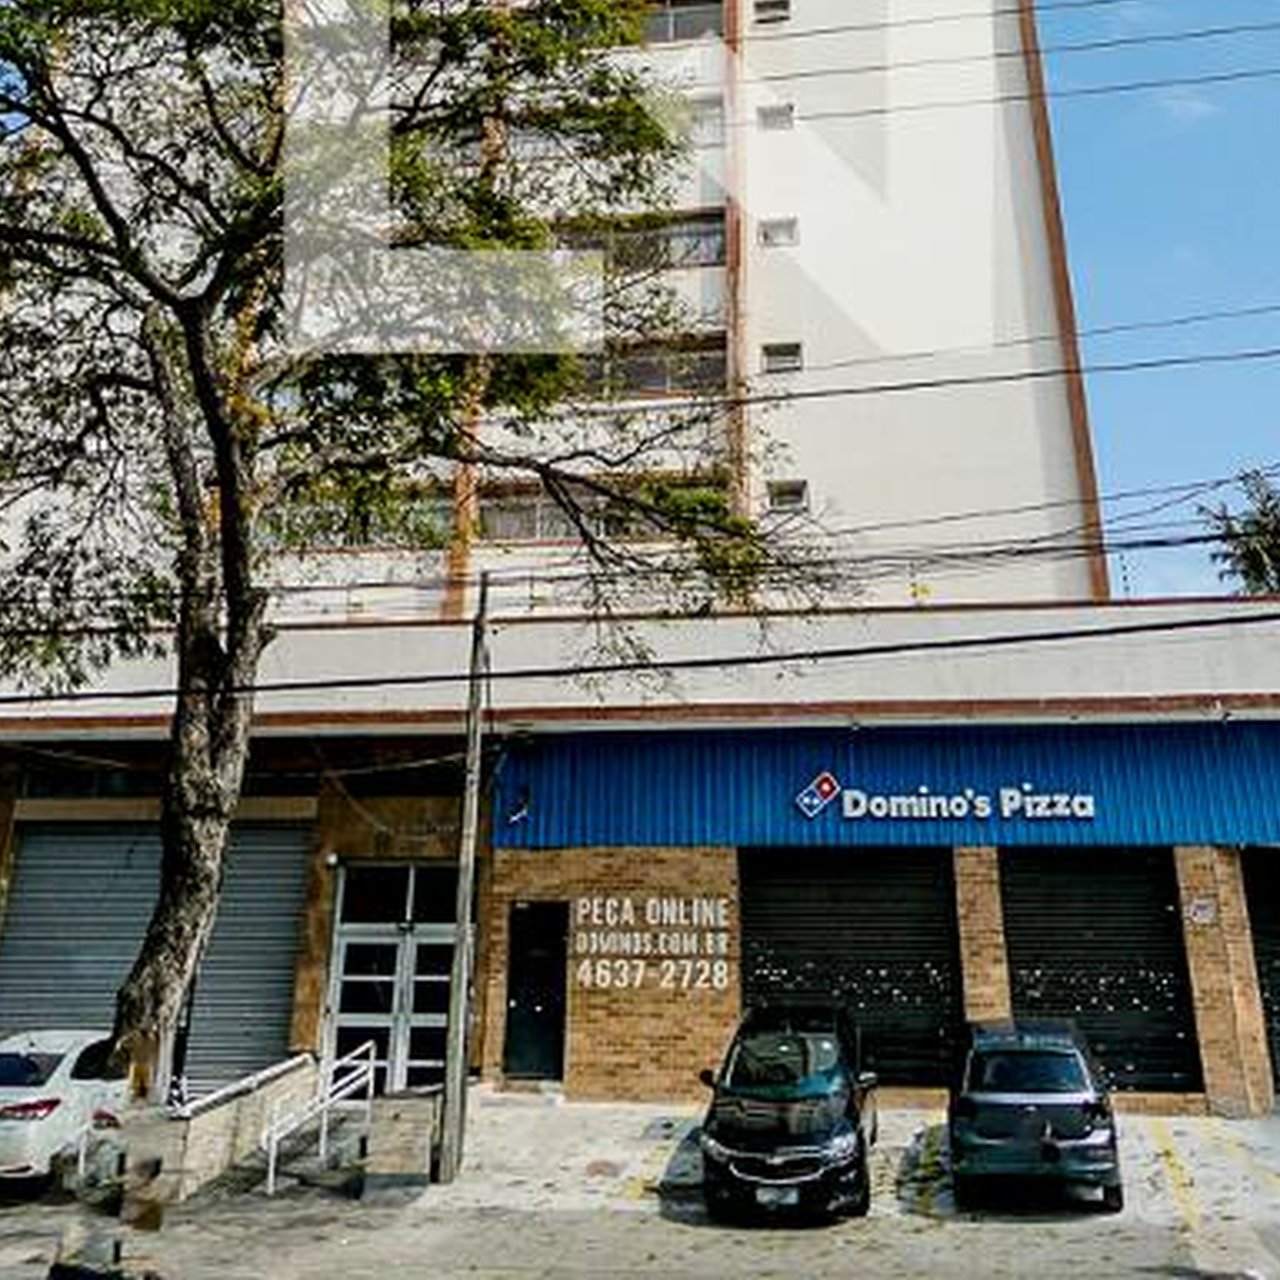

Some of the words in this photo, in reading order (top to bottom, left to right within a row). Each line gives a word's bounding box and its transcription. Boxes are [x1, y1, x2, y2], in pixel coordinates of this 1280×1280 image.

[842, 784, 992, 818] Domino's
[999, 782, 1095, 818] Pizza
[646, 897, 729, 926] ONLINE
[576, 958, 729, 990] 4637-2728
